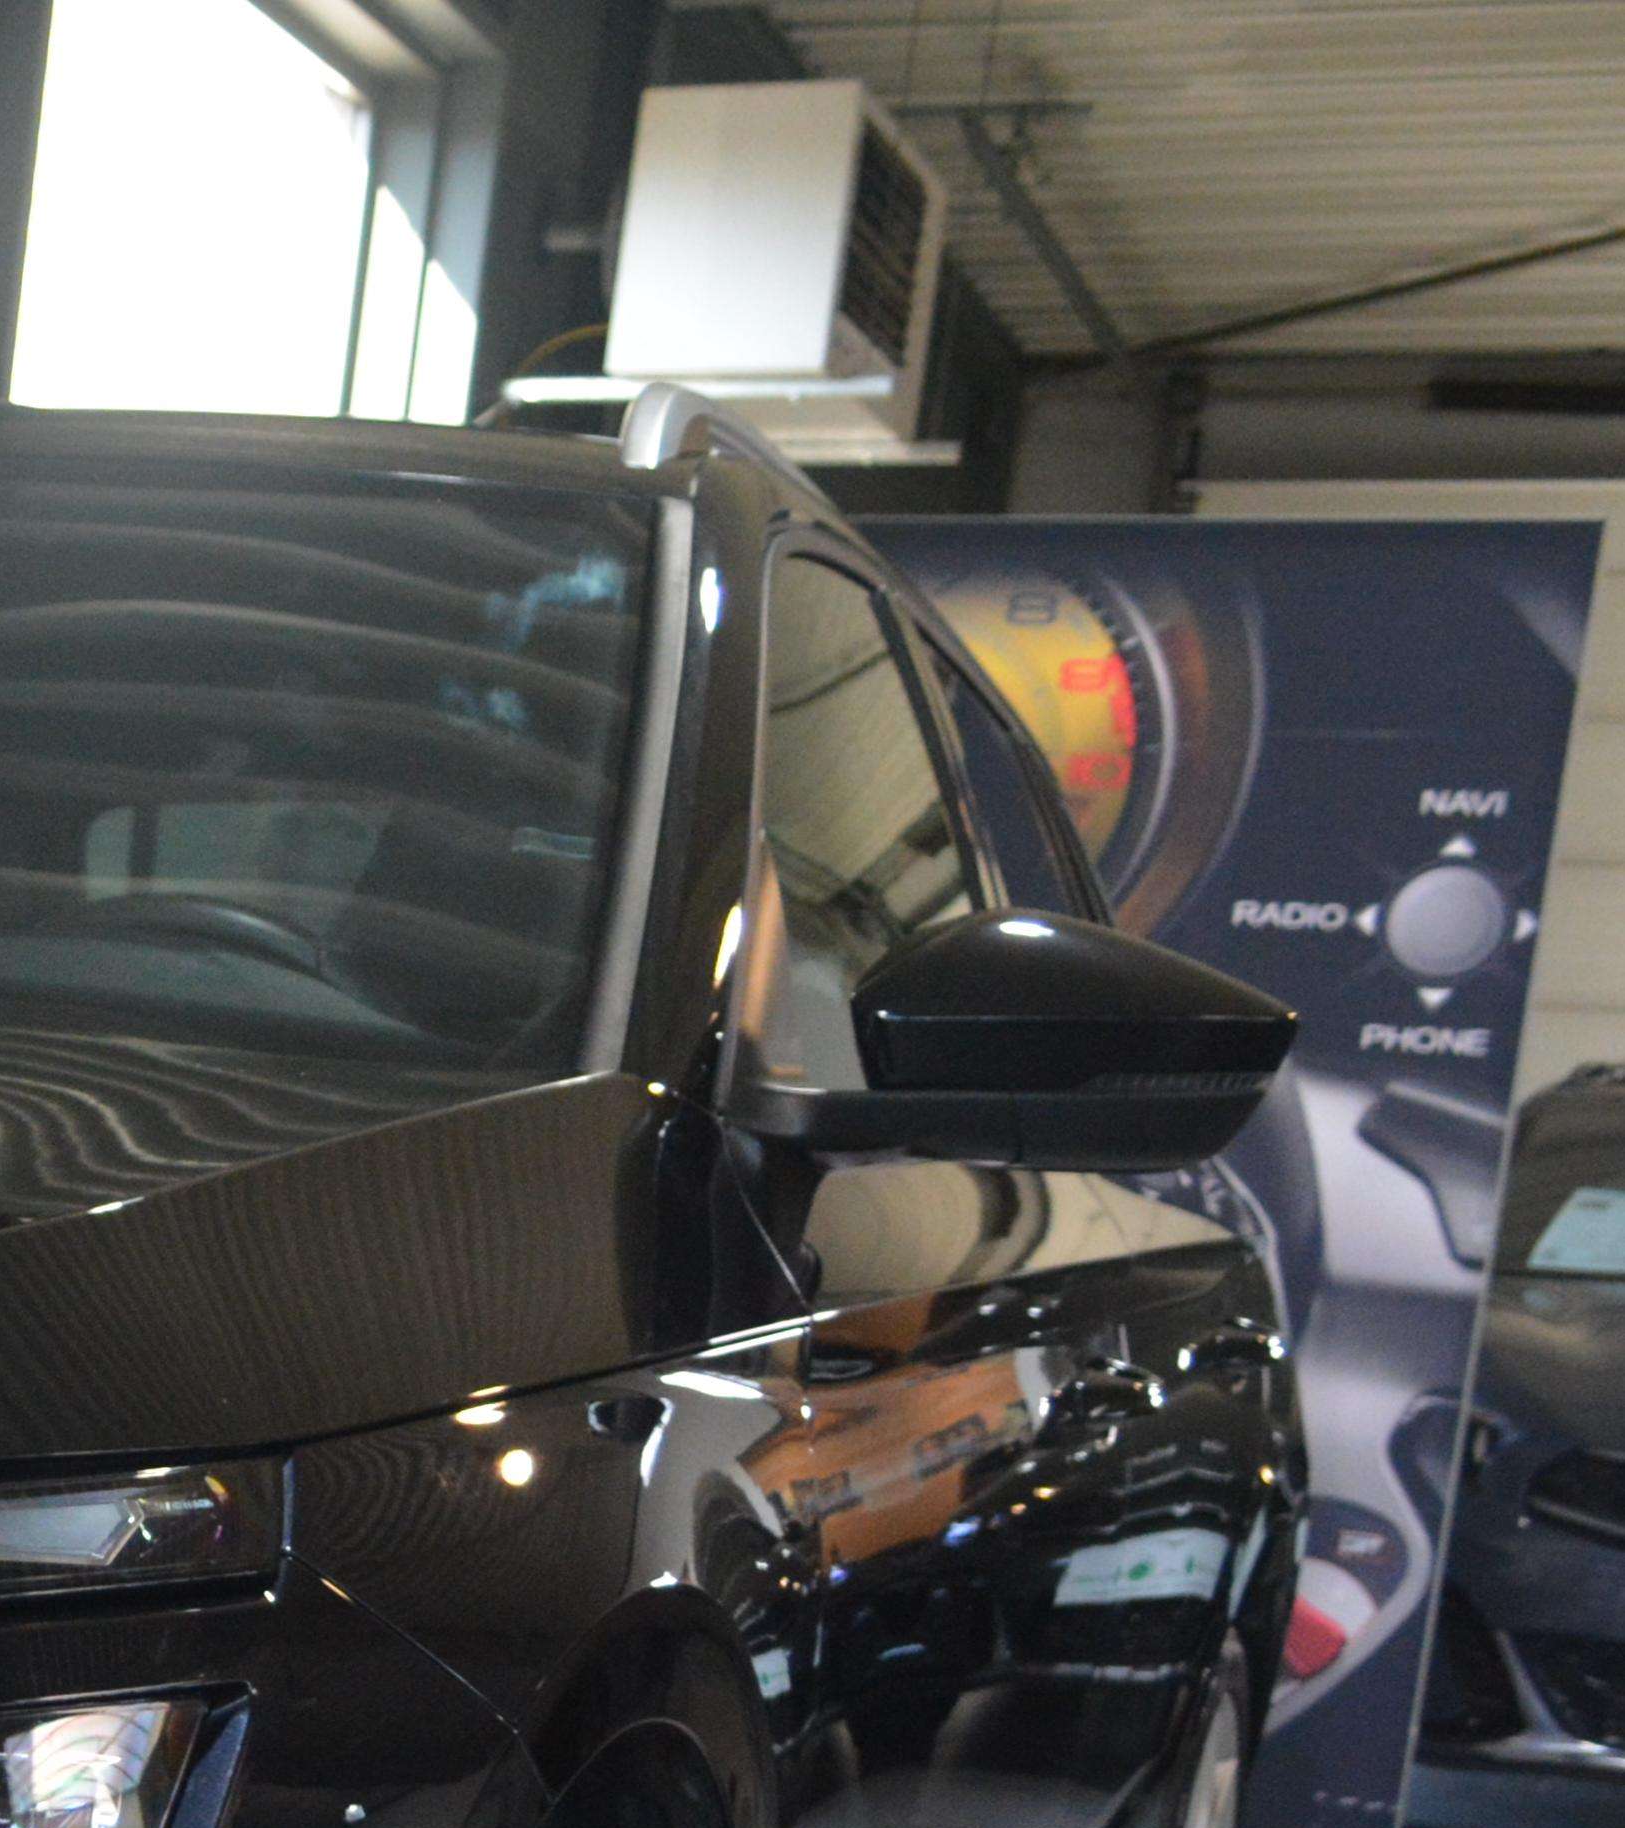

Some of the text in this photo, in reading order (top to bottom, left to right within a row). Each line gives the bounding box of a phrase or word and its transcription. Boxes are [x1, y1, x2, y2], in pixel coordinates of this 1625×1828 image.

[1418, 788, 1510, 817] NAVI
[1231, 899, 1349, 931] RADIO
[1359, 1022, 1492, 1057] PHONE
